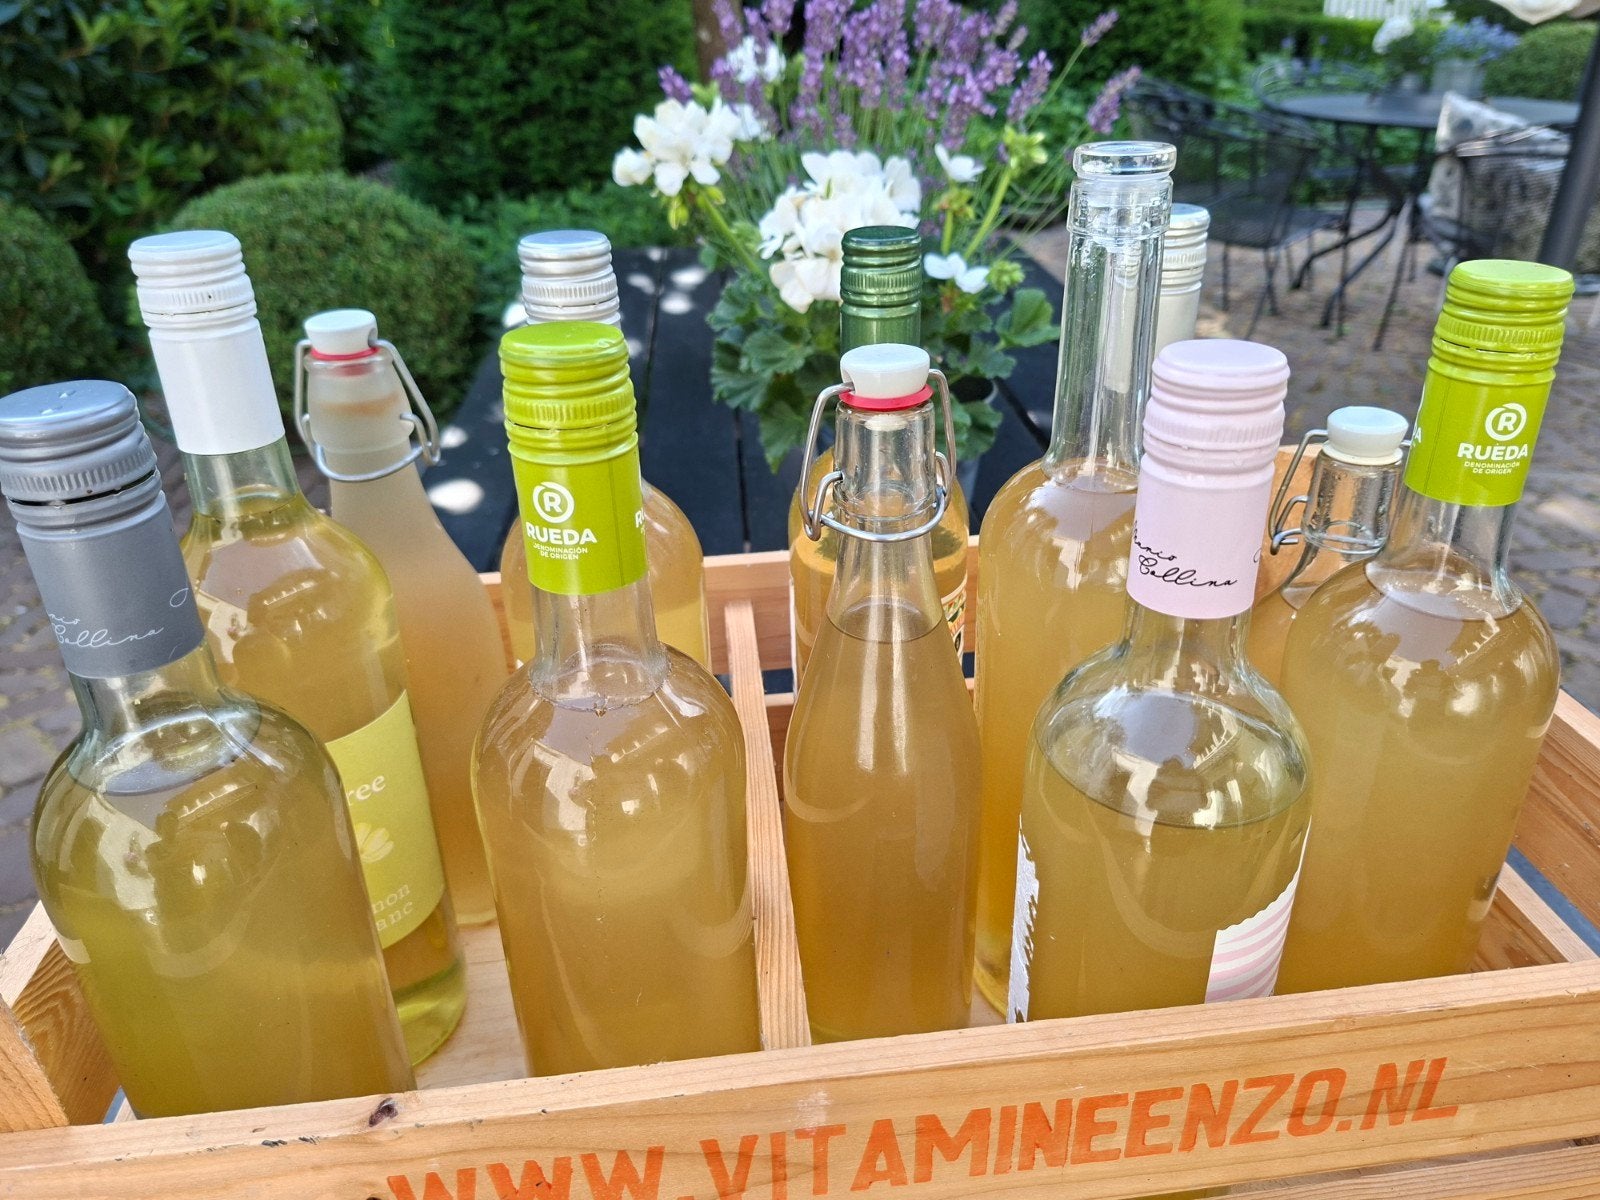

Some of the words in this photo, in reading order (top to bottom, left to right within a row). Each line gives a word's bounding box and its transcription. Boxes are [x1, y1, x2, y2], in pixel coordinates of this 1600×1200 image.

[1456, 442, 1529, 461] RUEDA
[1464, 461, 1520, 469] DENOMINACIÓN
[1485, 467, 1513, 475] ORIGEN
[525, 521, 599, 546] RUEDA
[540, 550, 550, 558] DE
[550, 552, 579, 560] ORIGEN
[1138, 554, 1238, 587] Collina
[345, 775, 386, 806] ree
